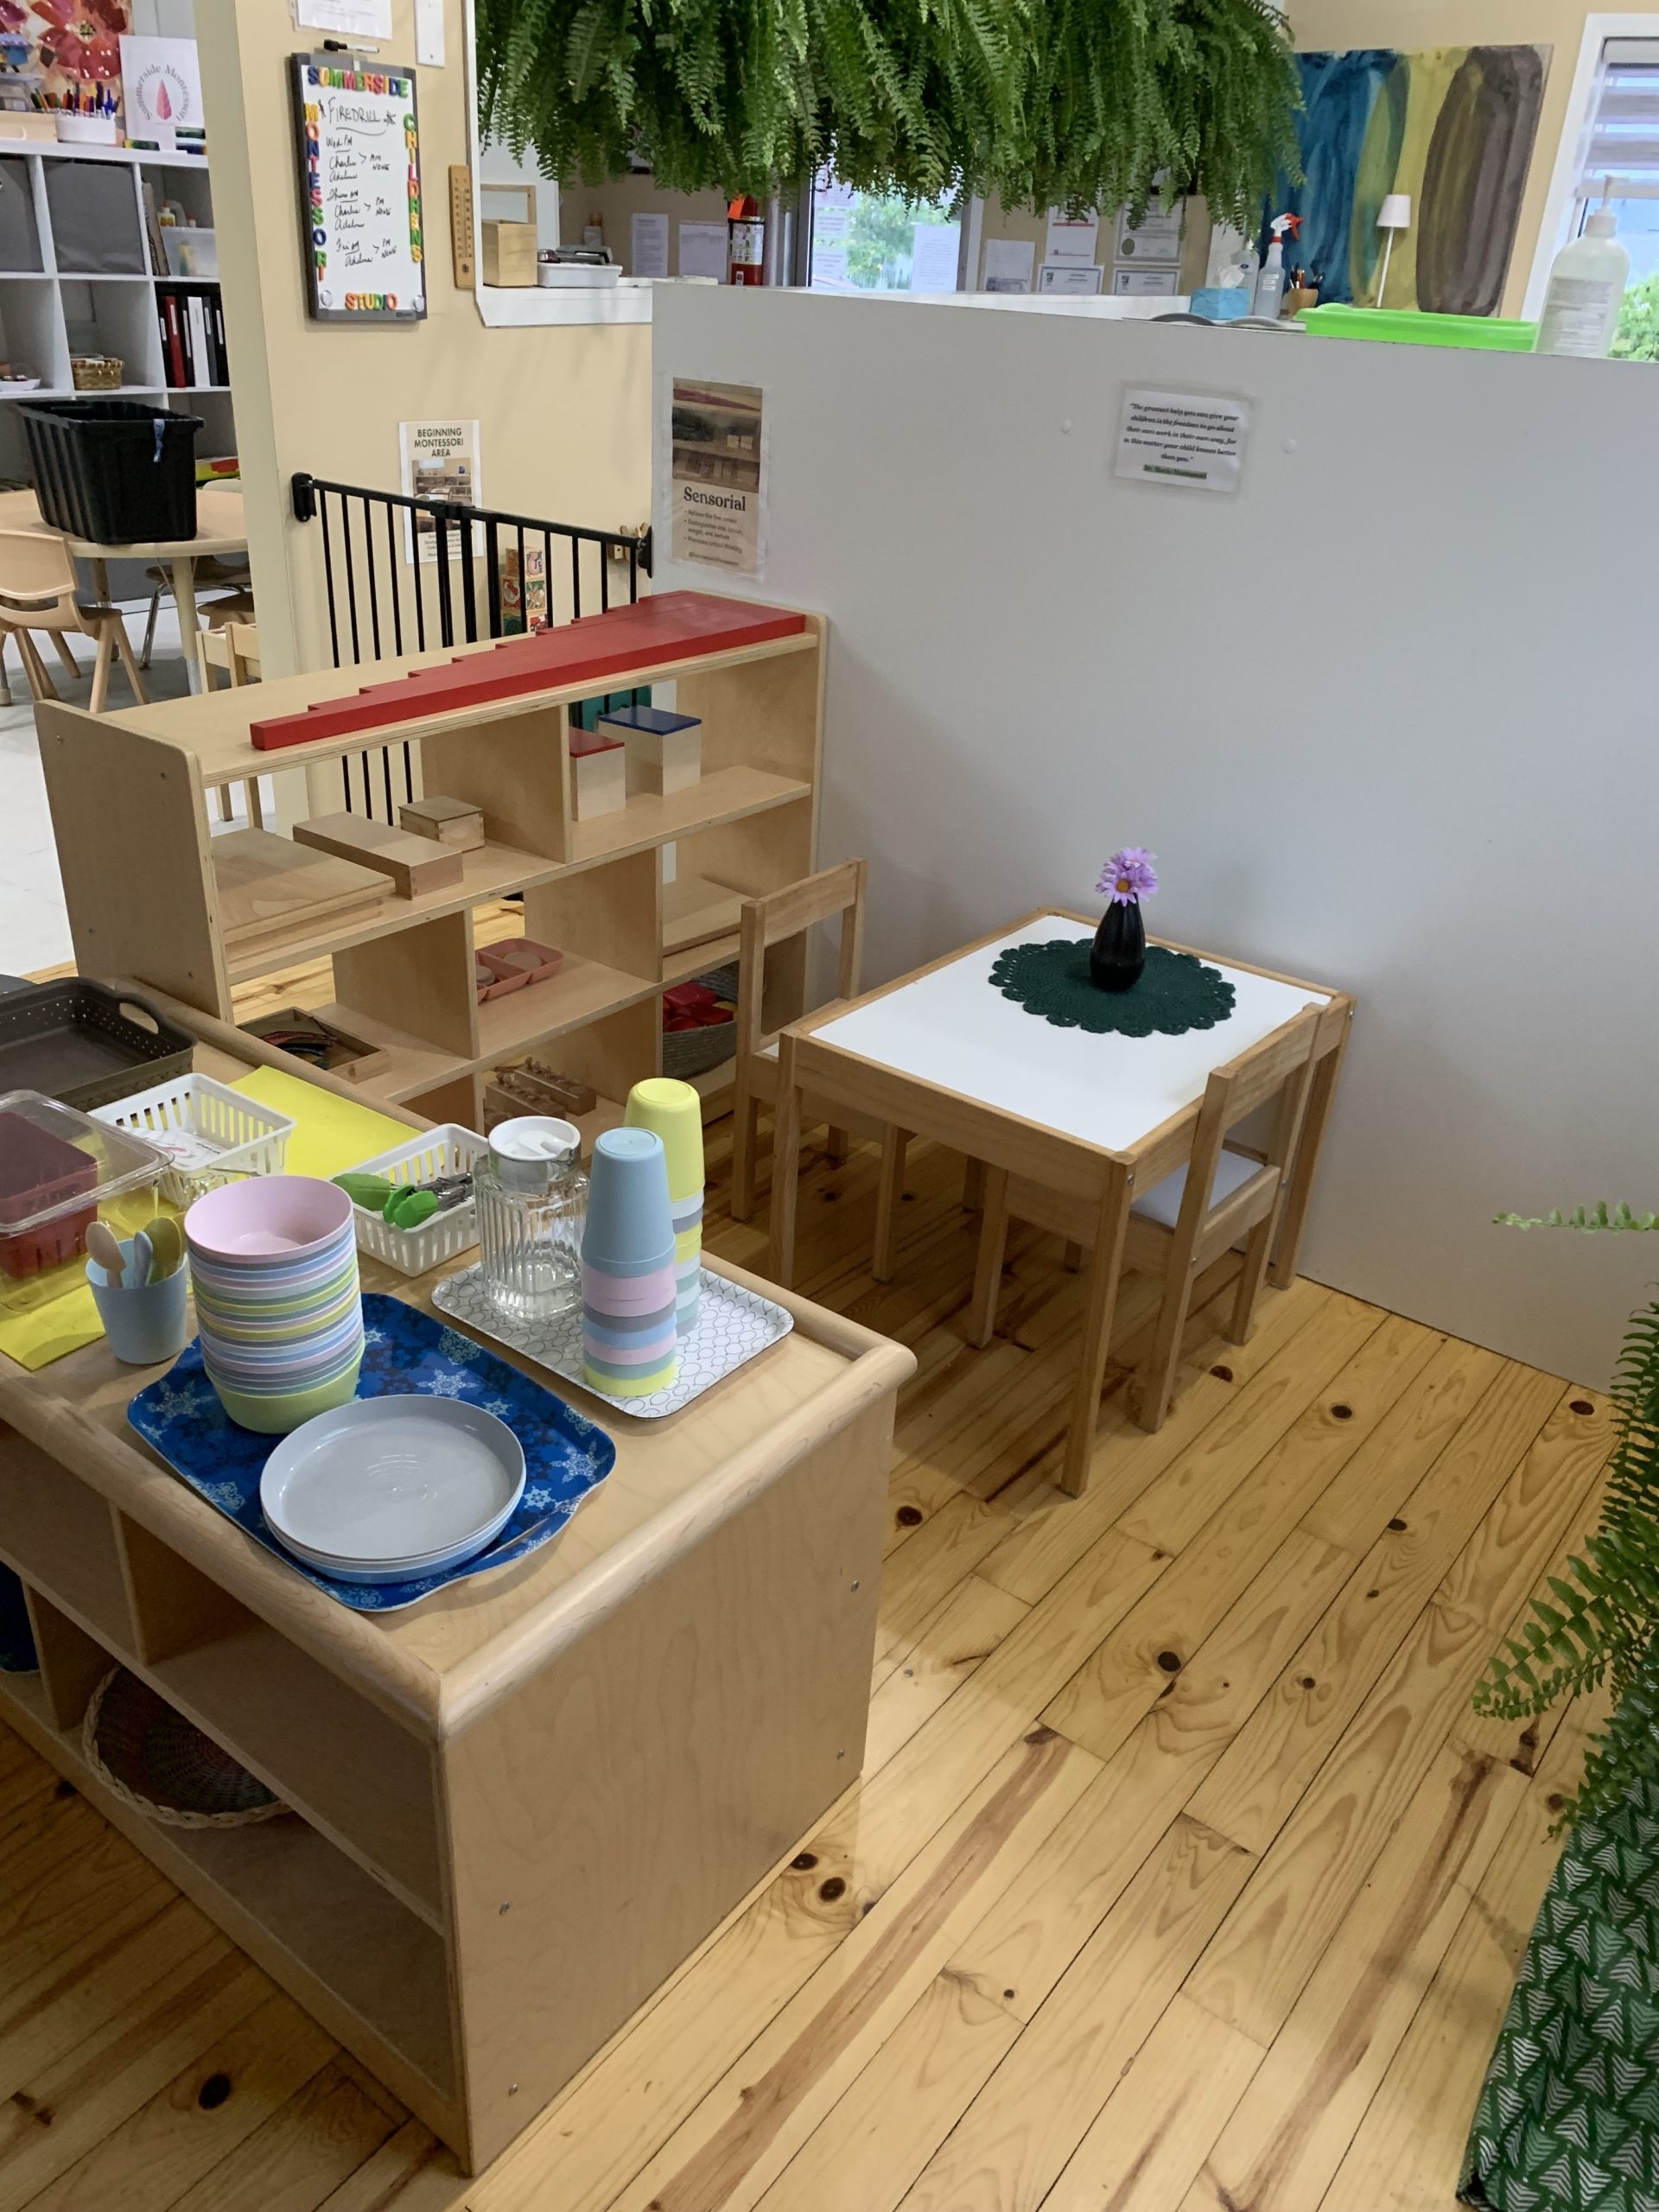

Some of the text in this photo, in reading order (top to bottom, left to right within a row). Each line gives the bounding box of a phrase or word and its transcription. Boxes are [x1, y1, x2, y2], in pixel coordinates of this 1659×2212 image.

[136, 63, 162, 120] Summerside
[307, 66, 409, 98] SUMMERSIDE
[305, 103, 327, 282] MONTESSORI
[345, 293, 398, 310] STUDIO
[414, 438, 464, 448] MONTESSORI
[417, 428, 462, 437] BEGINNING
[431, 448, 451, 457] AREA
[683, 486, 746, 512] Sensorial
